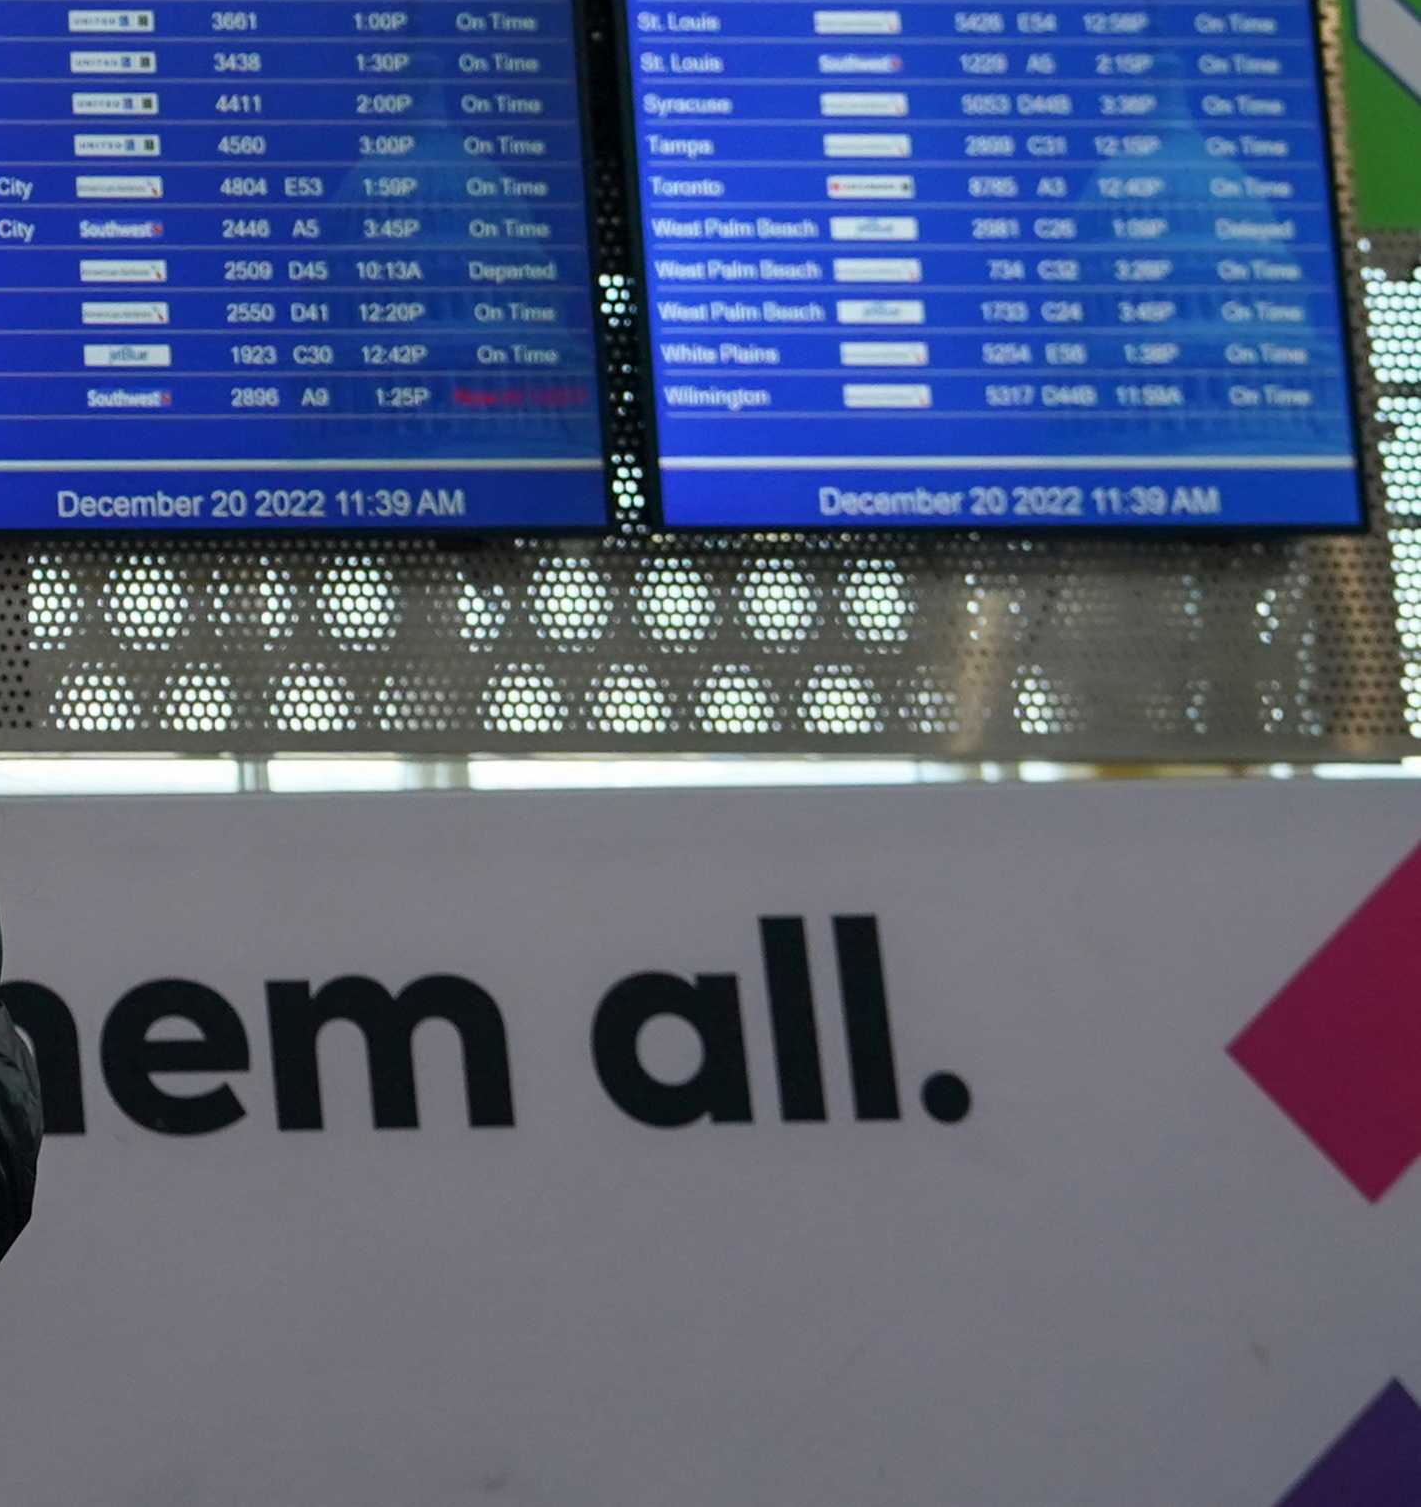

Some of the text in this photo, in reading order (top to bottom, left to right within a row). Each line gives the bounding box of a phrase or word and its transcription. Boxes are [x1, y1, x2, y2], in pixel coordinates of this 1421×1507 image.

[641, 53, 723, 73] St. Louis
[647, 135, 713, 158] Tampa
[650, 176, 724, 196] Toronto
[664, 386, 770, 411] Wilmington
[58, 489, 464, 517] December 20 2022 11:39 AM
[819, 486, 1220, 515] December 20 2022 11:39 AM
[590, 914, 971, 1128] all.
